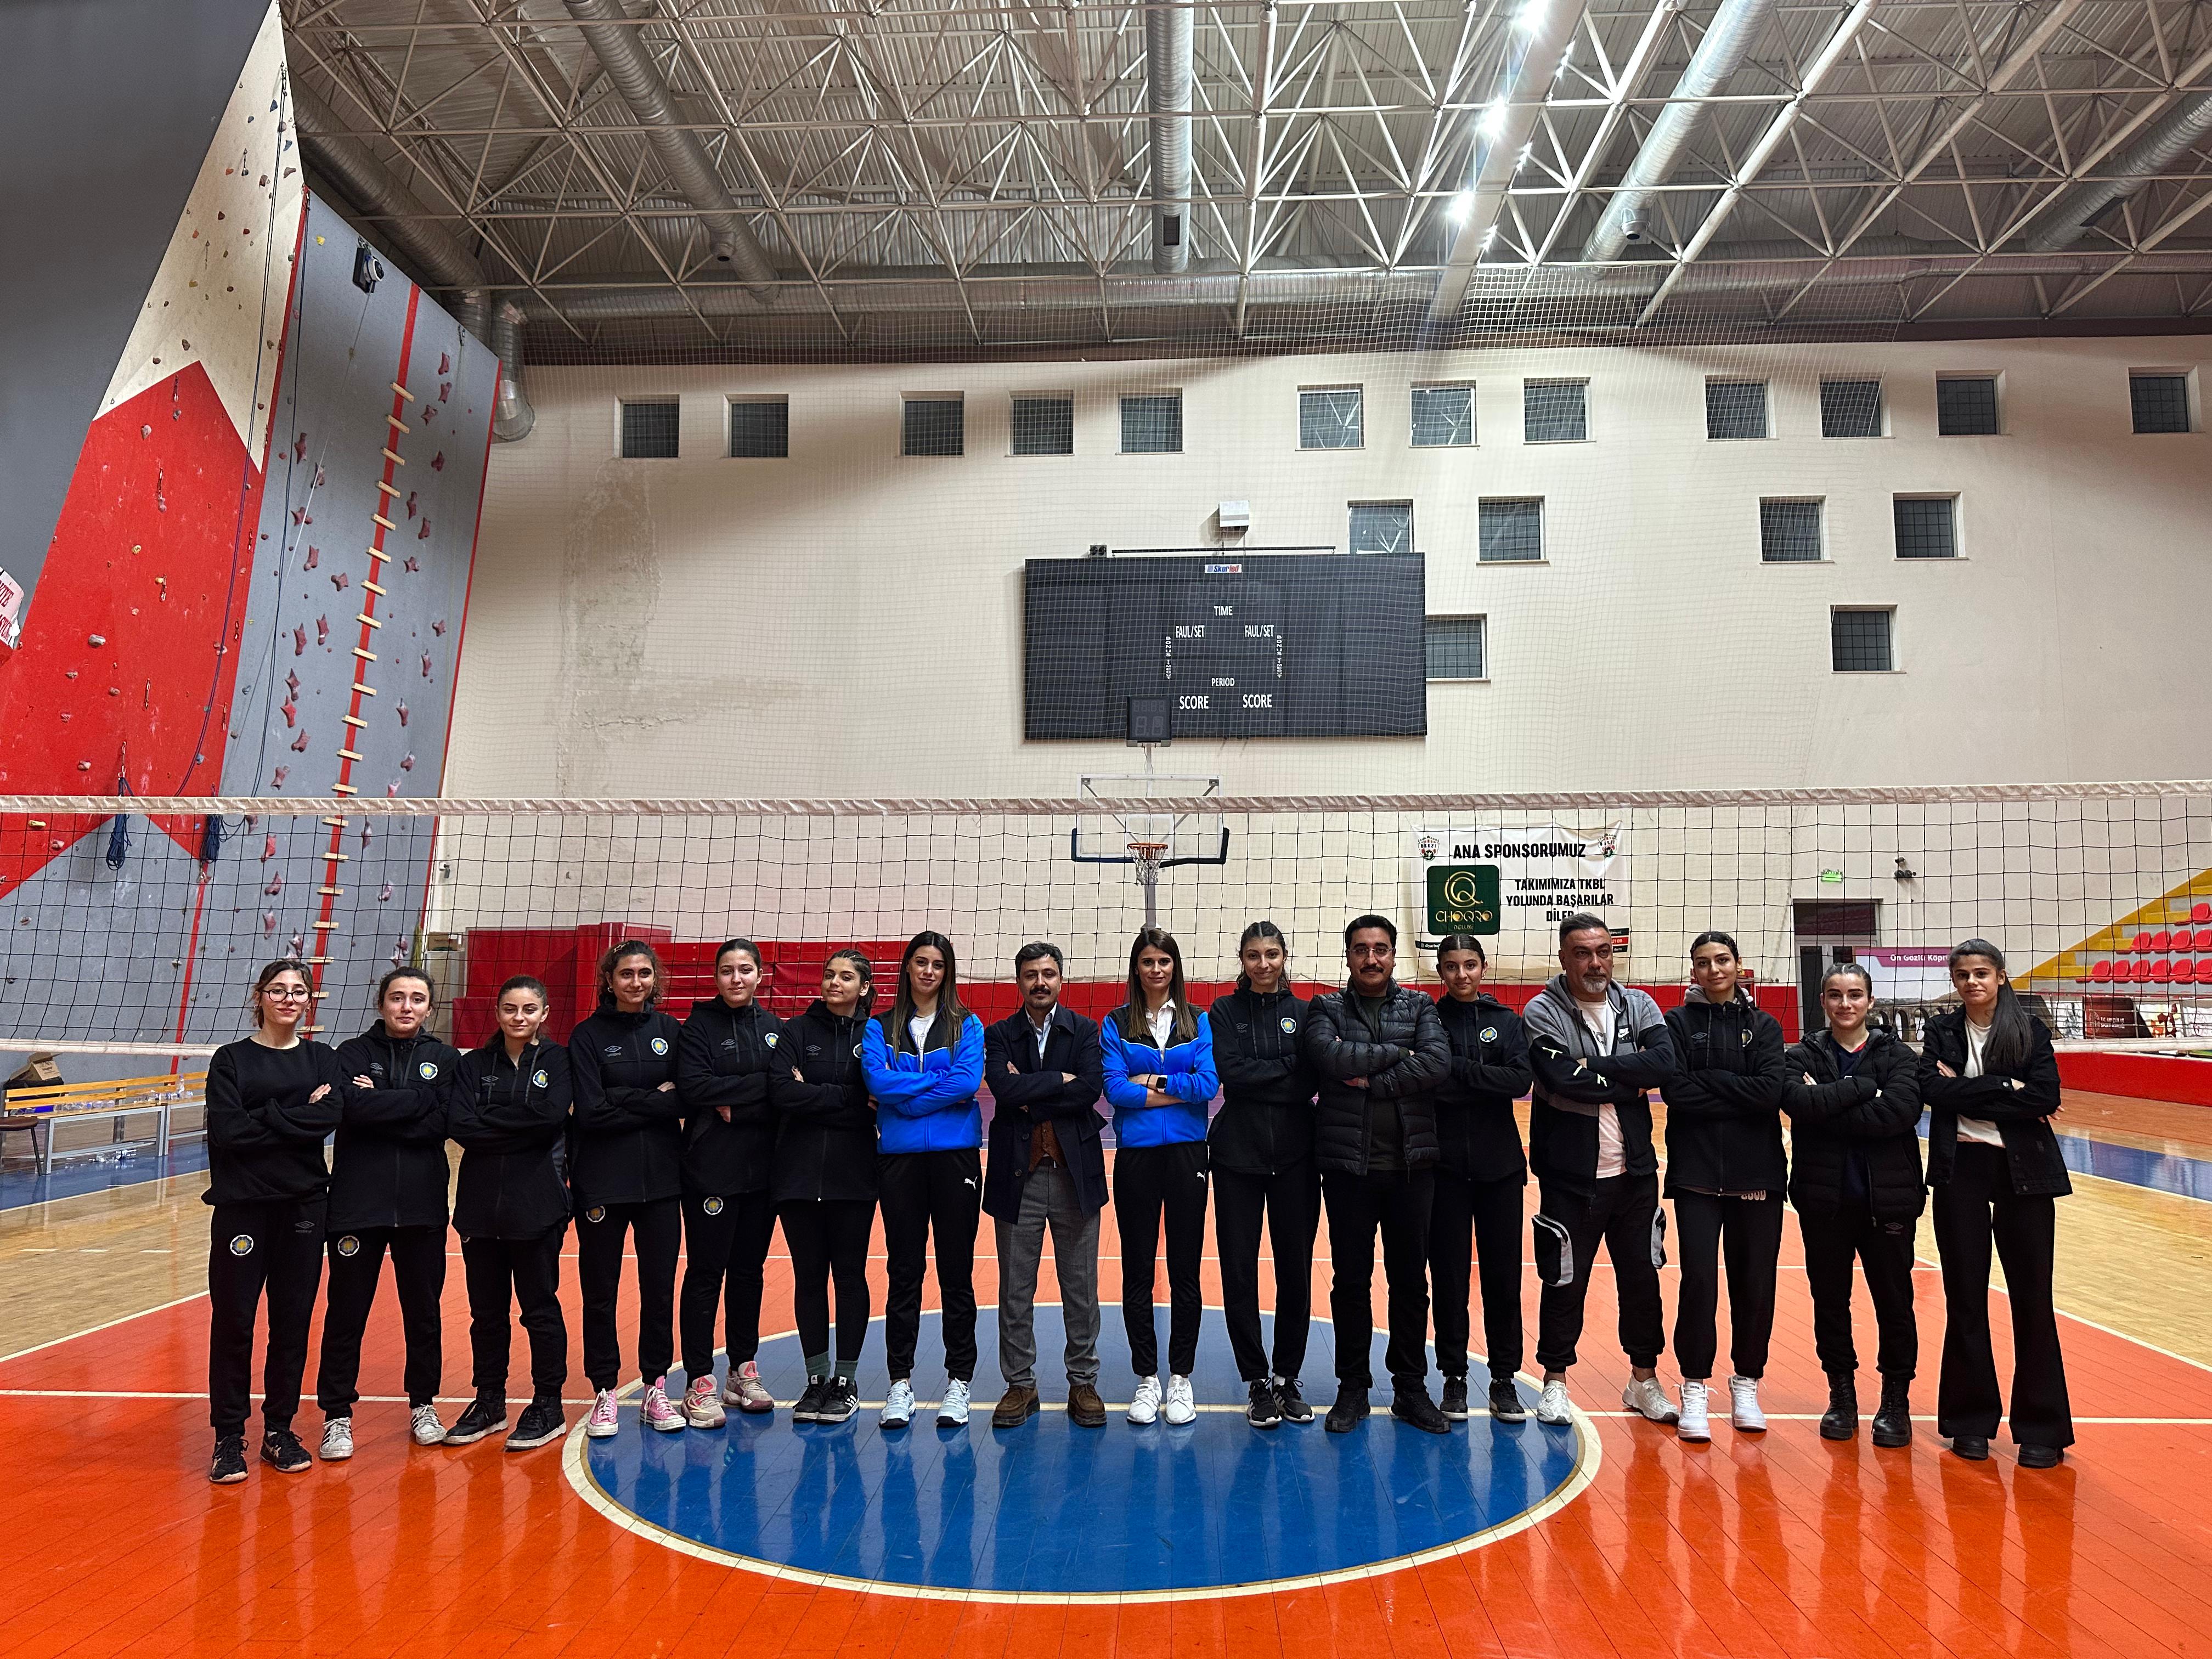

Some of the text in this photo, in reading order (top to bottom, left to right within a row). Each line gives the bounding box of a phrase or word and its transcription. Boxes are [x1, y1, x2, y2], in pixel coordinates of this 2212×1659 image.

[1214, 606, 1233, 616] TIME
[1176, 625, 1205, 638] FAUL/SET
[1245, 624, 1274, 637] FAUL/SET
[1211, 678, 1235, 687] PERIOD
[1179, 695, 1209, 710] SCORE
[1243, 694, 1272, 708] SCORE
[1453, 843, 1586, 859] ANA SPONSORUMUZ
[1515, 878, 1605, 890] TAKIMIMIZA TKBL
[1506, 894, 1614, 908] YOLUNDA BAŞARILAR
